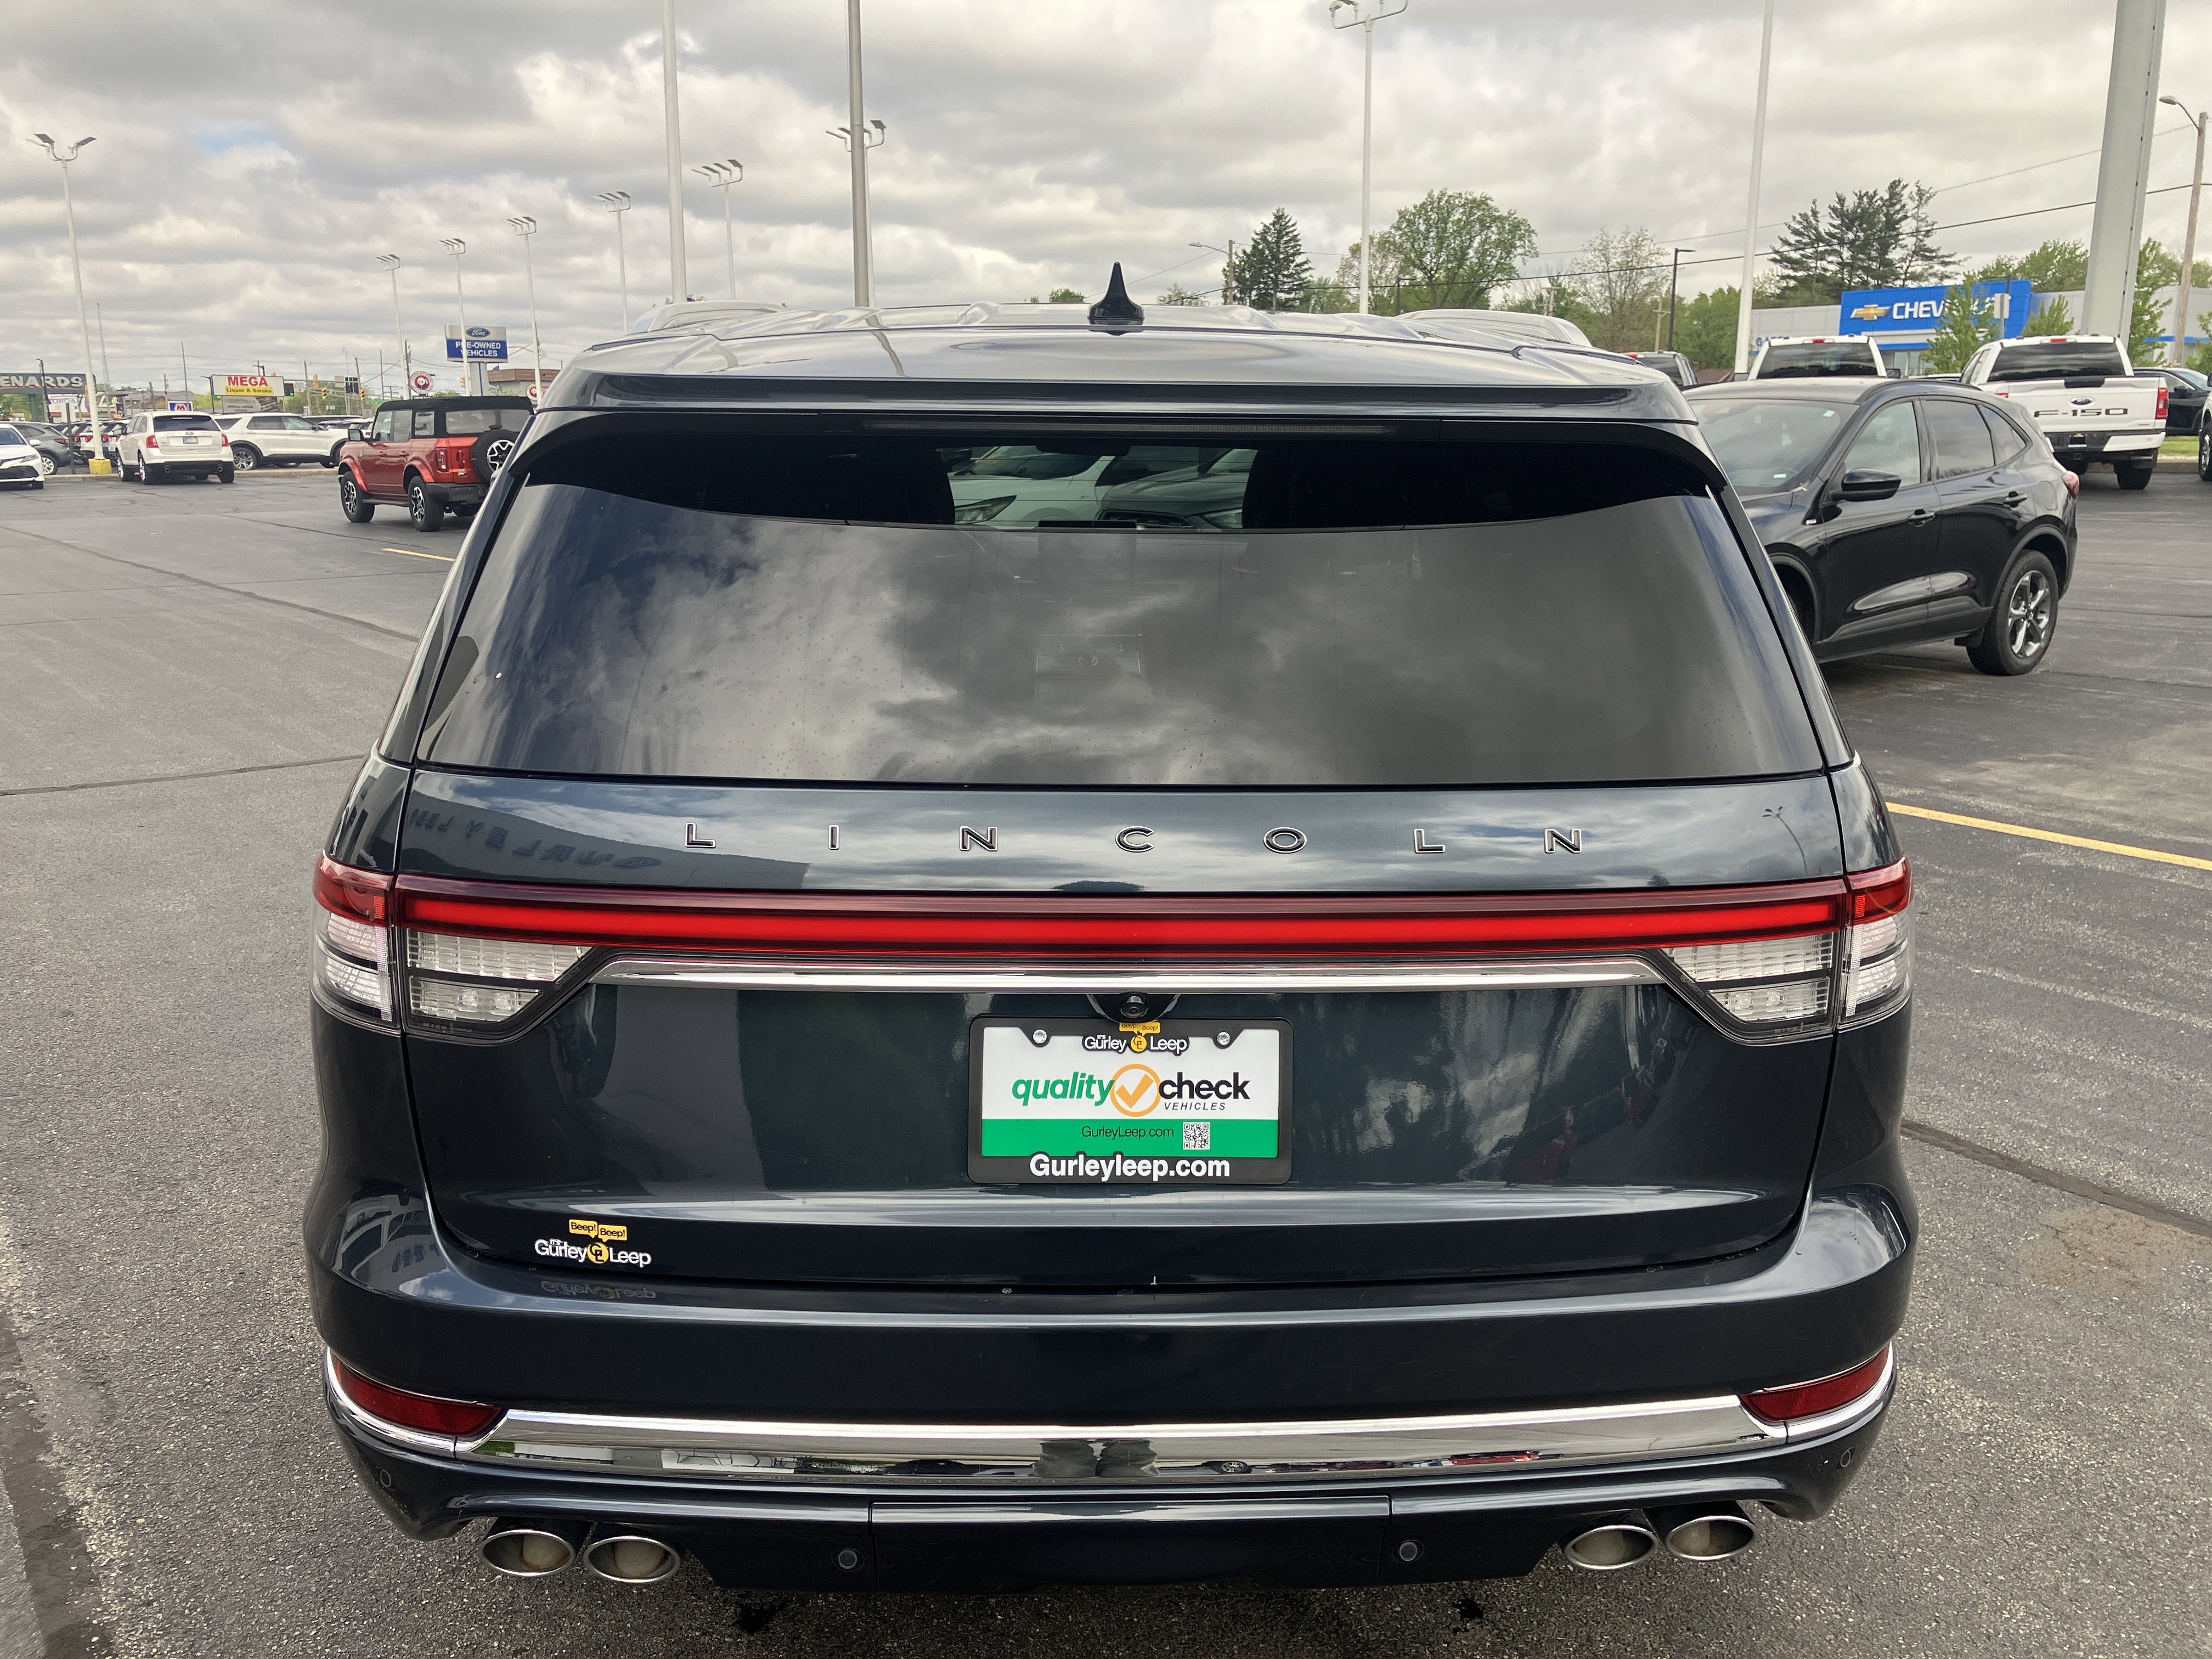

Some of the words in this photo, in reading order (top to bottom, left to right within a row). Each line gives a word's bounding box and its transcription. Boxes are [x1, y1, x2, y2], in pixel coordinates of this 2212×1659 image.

[0, 376, 82, 387] ENARDS
[228, 376, 268, 386] MEGA
[2034, 408, 2128, 417] F-150
[685, 822, 1582, 854] LINCOLN
[1150, 1036, 1187, 1054] Leep
[1012, 1071, 1116, 1107] quality
[1158, 1071, 1251, 1100] check
[1164, 1102, 1226, 1110] VEHICLES
[1081, 1125, 1174, 1140] GurleyLeep.com
[1029, 1154, 1230, 1182] Gurleyleep.com
[571, 1222, 596, 1233] Beep!
[600, 1228, 625, 1239] Beep!
[534, 1239, 588, 1263] Gurley
[609, 1247, 652, 1268] Leep
